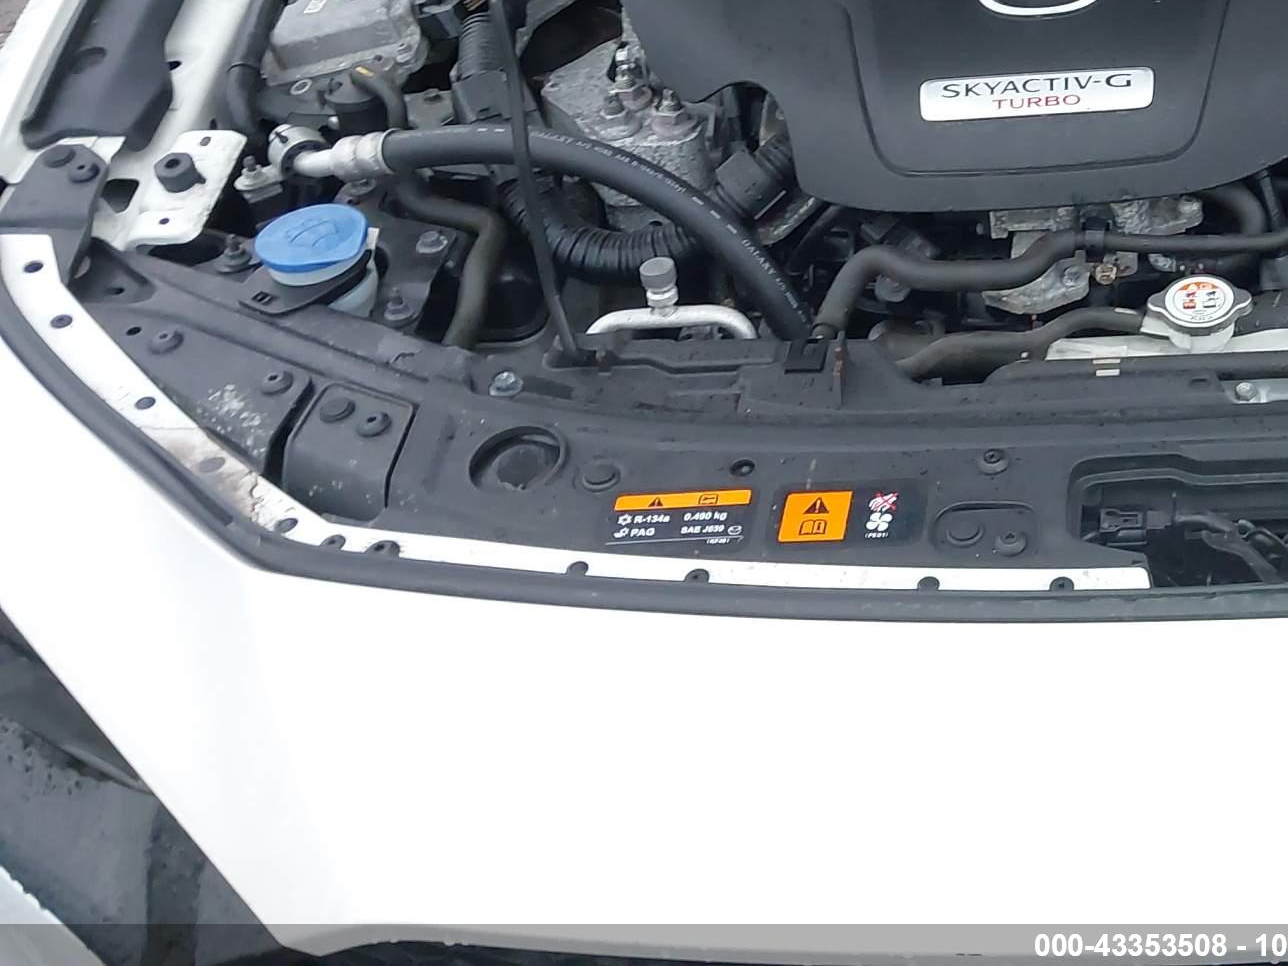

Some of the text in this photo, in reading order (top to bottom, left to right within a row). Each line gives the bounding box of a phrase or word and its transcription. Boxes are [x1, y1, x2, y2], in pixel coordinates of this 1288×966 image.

[941, 73, 1132, 99] SKYACTIV-G
[992, 94, 1081, 110] TURBO
[713, 510, 729, 521] kg
